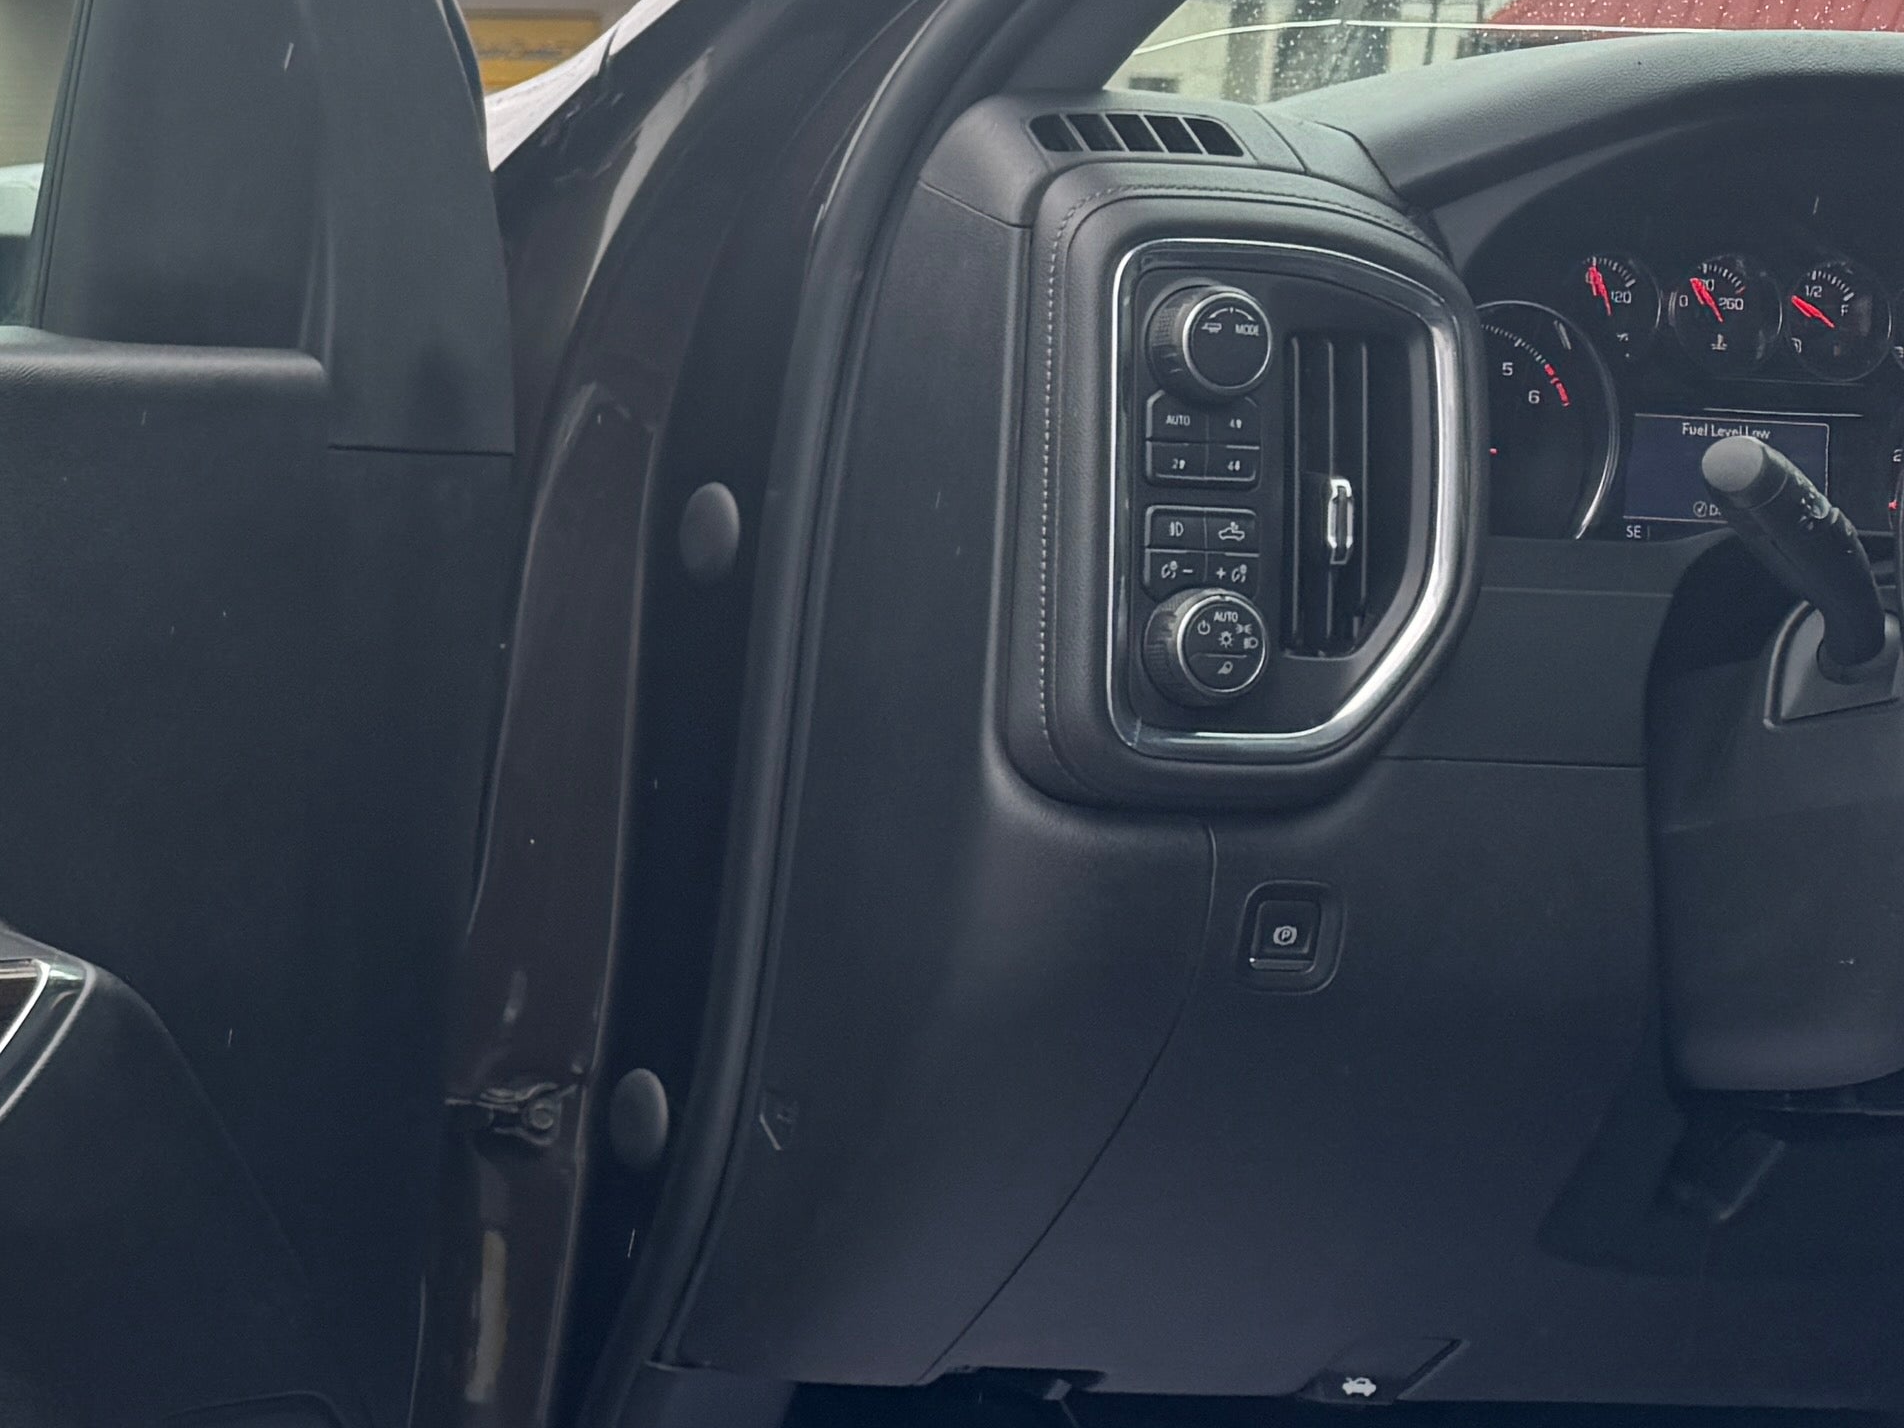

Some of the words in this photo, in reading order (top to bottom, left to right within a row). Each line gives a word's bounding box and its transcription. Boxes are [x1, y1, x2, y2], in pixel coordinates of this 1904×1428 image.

[1805, 284, 1823, 298] 1/2
[1235, 323, 1260, 338] MODE
[1502, 361, 1513, 376] 5
[1528, 389, 1540, 404] 6
[1165, 414, 1191, 427] AUTO
[1682, 422, 1708, 437] Fuel
[1711, 424, 1742, 439] Level
[1626, 525, 1642, 539] SE
[1213, 609, 1239, 624] AUTO
